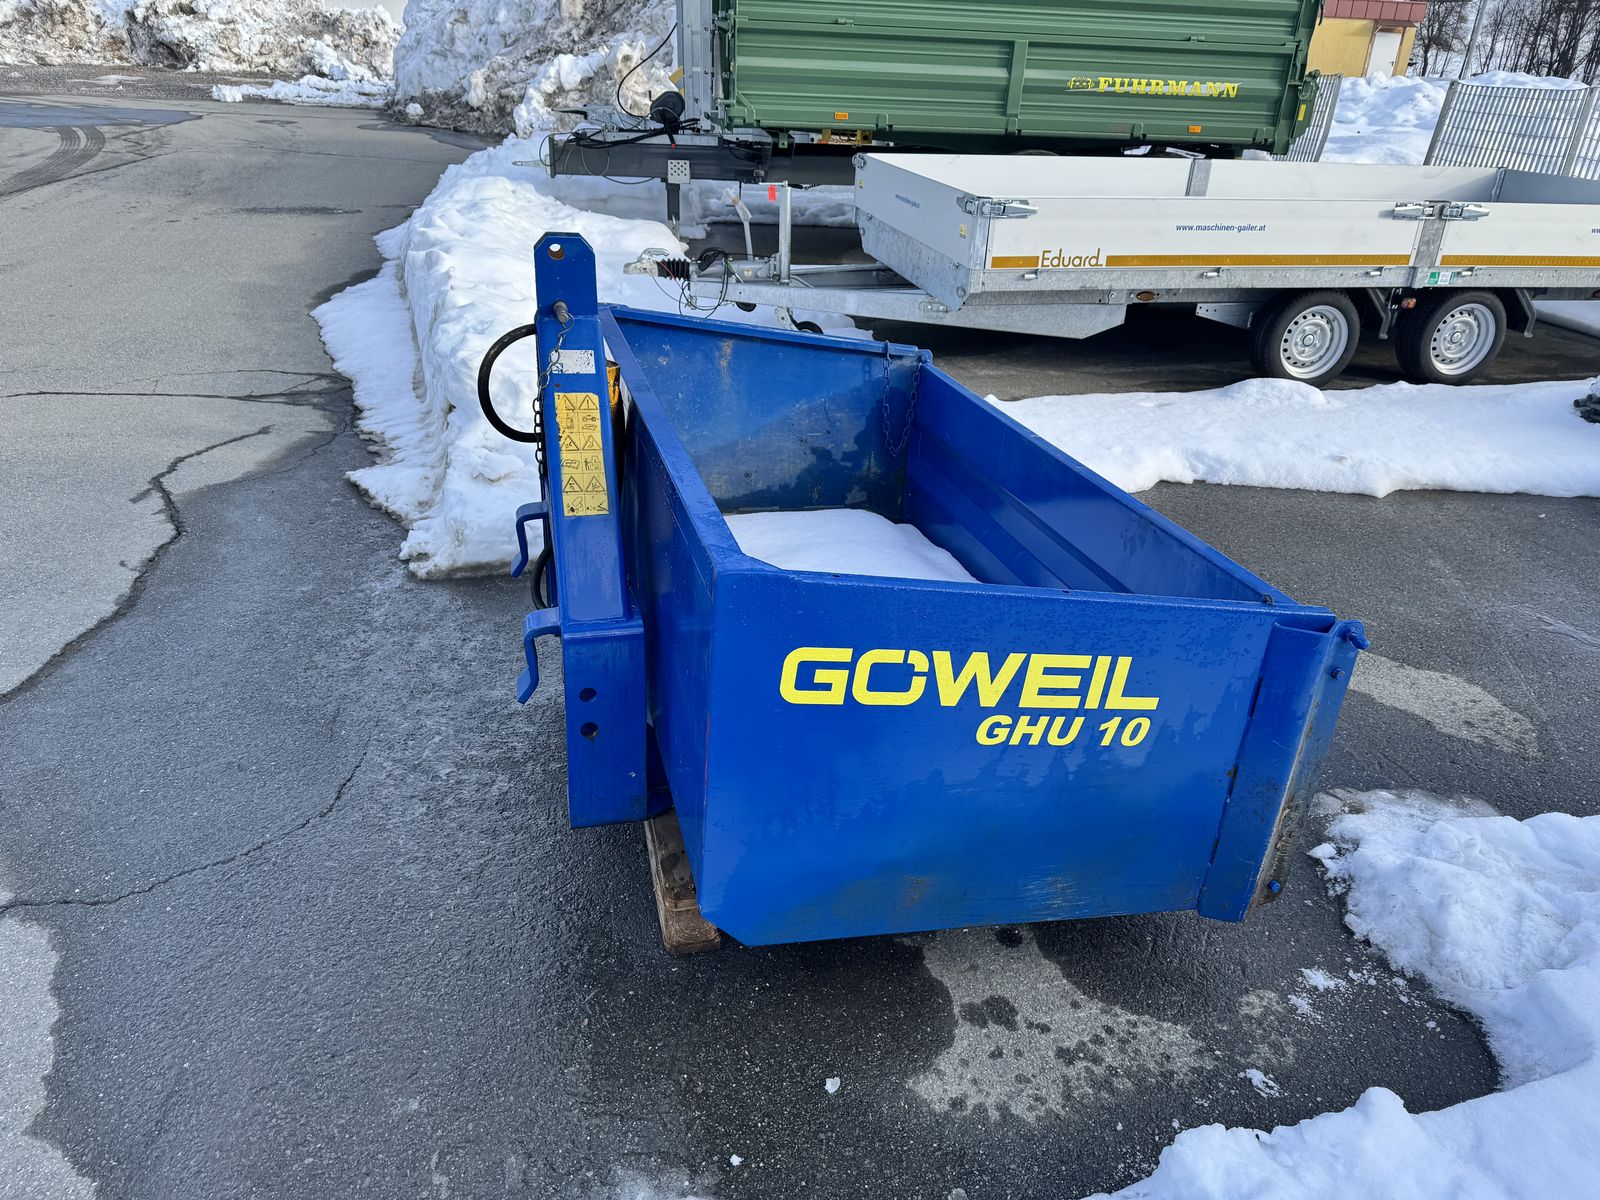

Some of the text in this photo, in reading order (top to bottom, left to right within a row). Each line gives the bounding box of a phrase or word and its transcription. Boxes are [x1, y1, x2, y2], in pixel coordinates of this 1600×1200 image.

[1096, 76, 1239, 98] FUHRMANN
[1176, 223, 1266, 233] www.maschinen-gailer.at
[1041, 248, 1103, 267] Eduard
[975, 714, 1151, 747] GHU 10
